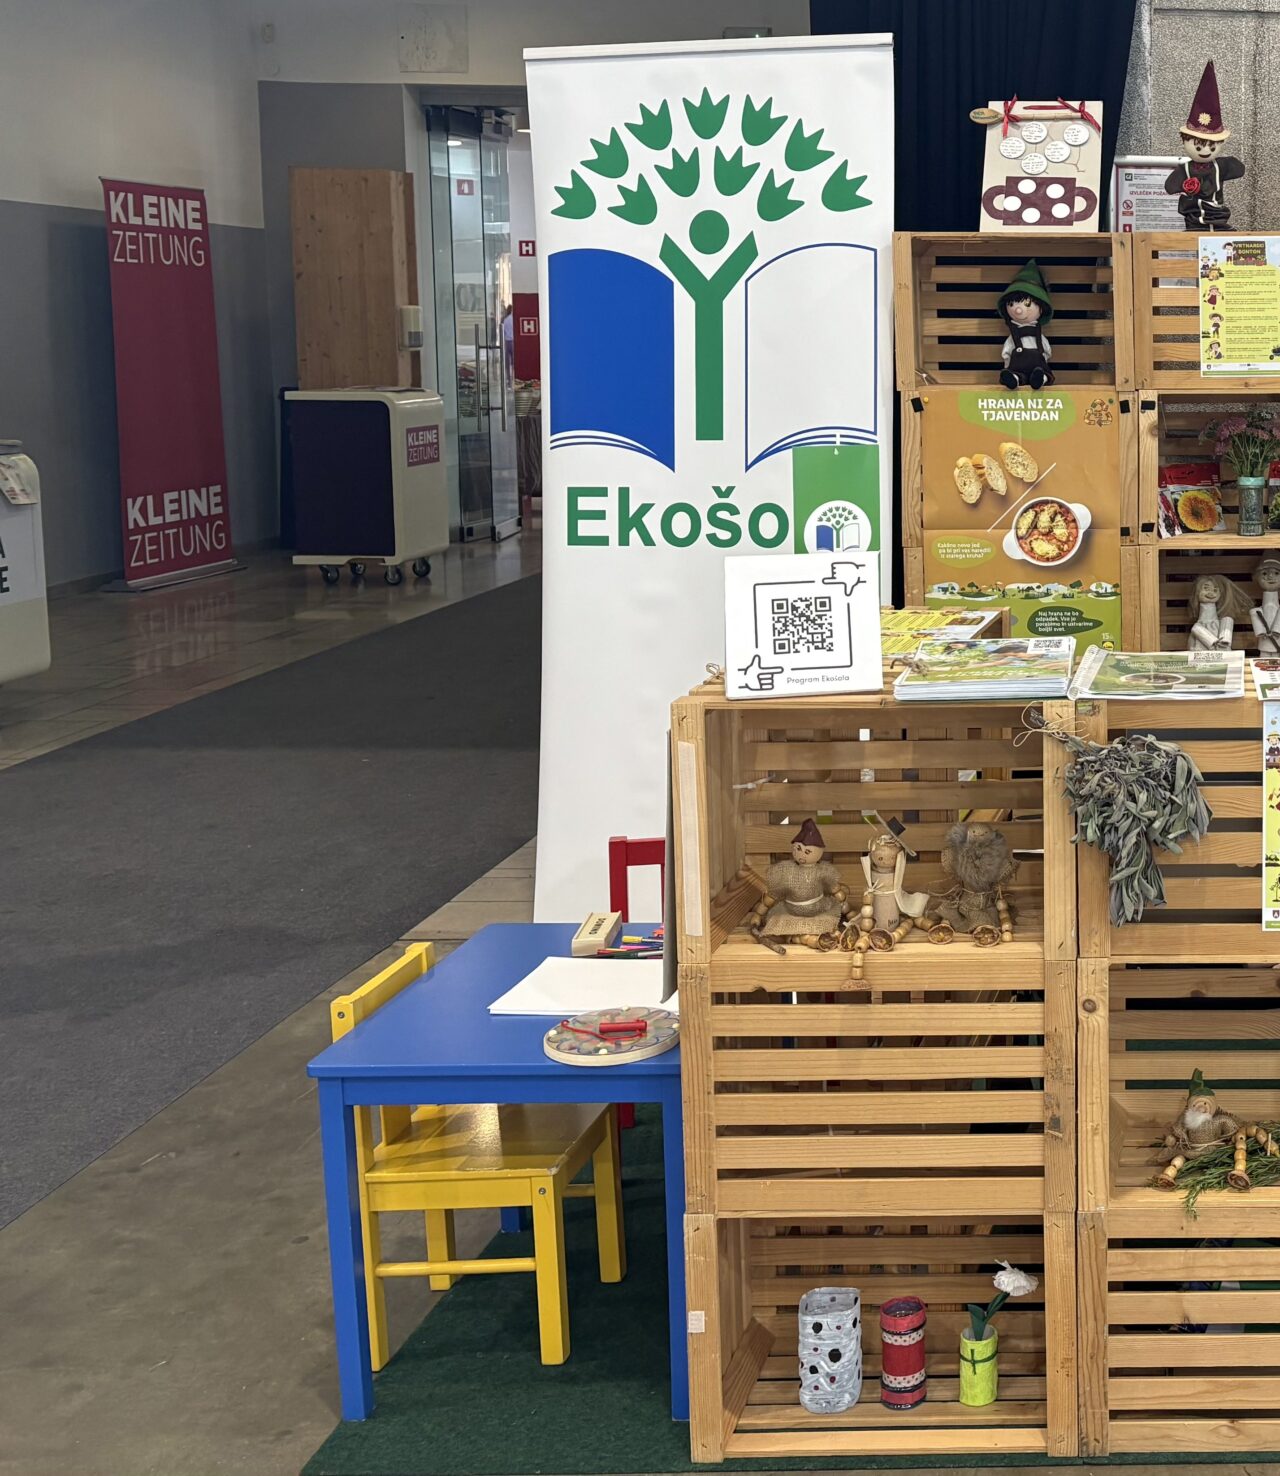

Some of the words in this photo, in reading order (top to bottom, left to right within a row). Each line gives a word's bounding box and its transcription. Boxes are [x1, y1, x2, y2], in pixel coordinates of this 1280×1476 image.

[109, 190, 203, 231] KLEINE
[112, 230, 205, 267] ZEITUNG
[978, 398, 1025, 409] HRANA
[1027, 398, 1044, 409] NI
[1046, 398, 1063, 409] ZA
[981, 410, 1059, 422] TJAVENDAN
[408, 430, 438, 446] KLEINE
[409, 444, 438, 463] ZEITUNG
[126, 484, 224, 530] KLEINE
[566, 485, 790, 549] Ekošo
[129, 520, 226, 567] ZEITUNG
[786, 676, 820, 685] Program
